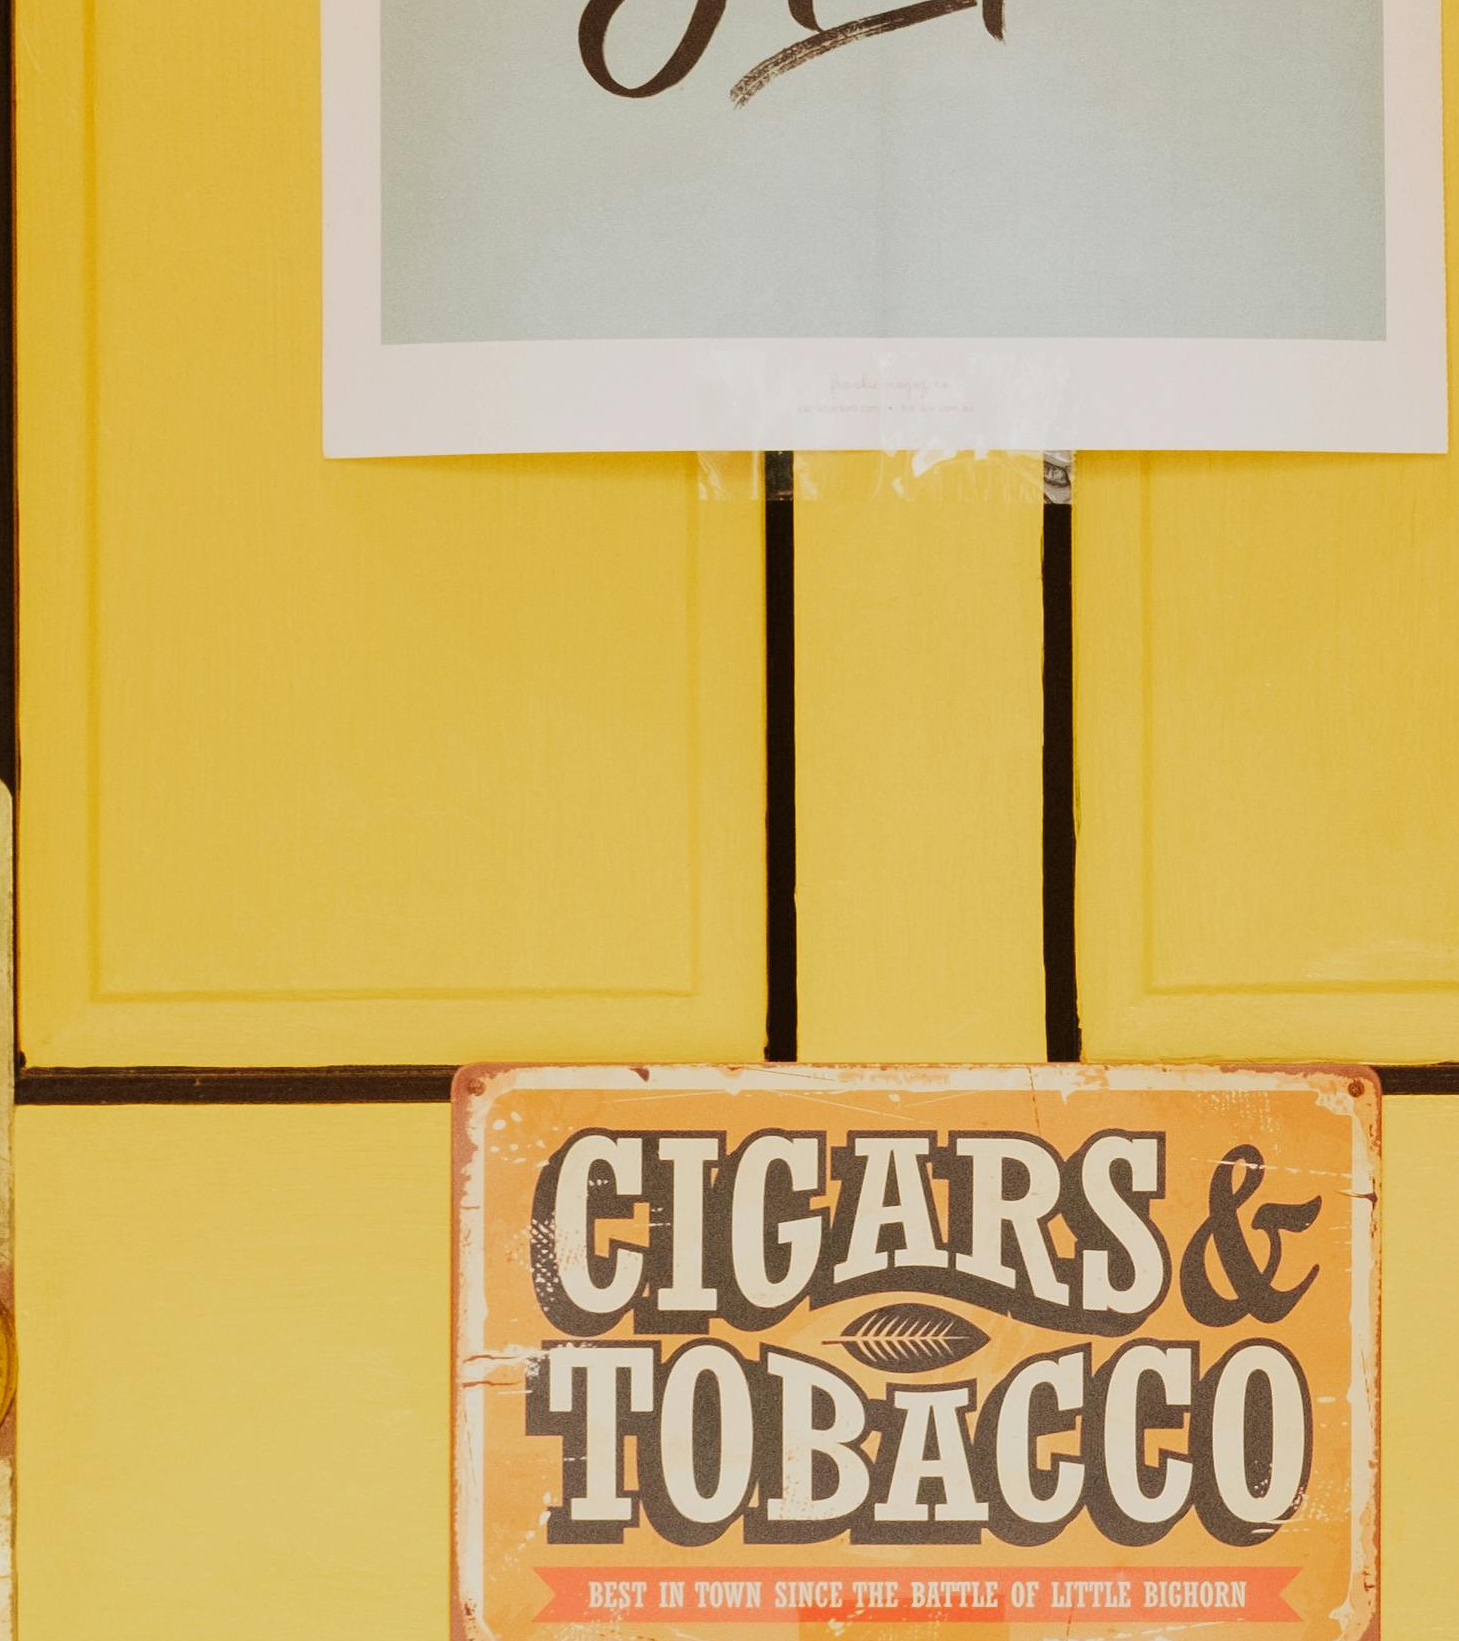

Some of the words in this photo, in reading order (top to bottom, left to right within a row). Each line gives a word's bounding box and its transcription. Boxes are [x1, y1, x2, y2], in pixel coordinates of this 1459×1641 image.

[532, 1127, 1170, 1337] CIGARS
[1179, 1143, 1323, 1329] &
[526, 1339, 1315, 1547] TOBACCO
[588, 1580, 647, 1608] BEST
[659, 1580, 685, 1608] IN
[695, 1580, 763, 1608] TOWN
[774, 1580, 843, 1608] SINCE
[852, 1580, 899, 1608] THE
[911, 1580, 998, 1608] BATTLE
[1011, 1580, 1039, 1608] OF
[1051, 1580, 1131, 1608] LITTLE
[1143, 1580, 1247, 1608] BIGHORN
